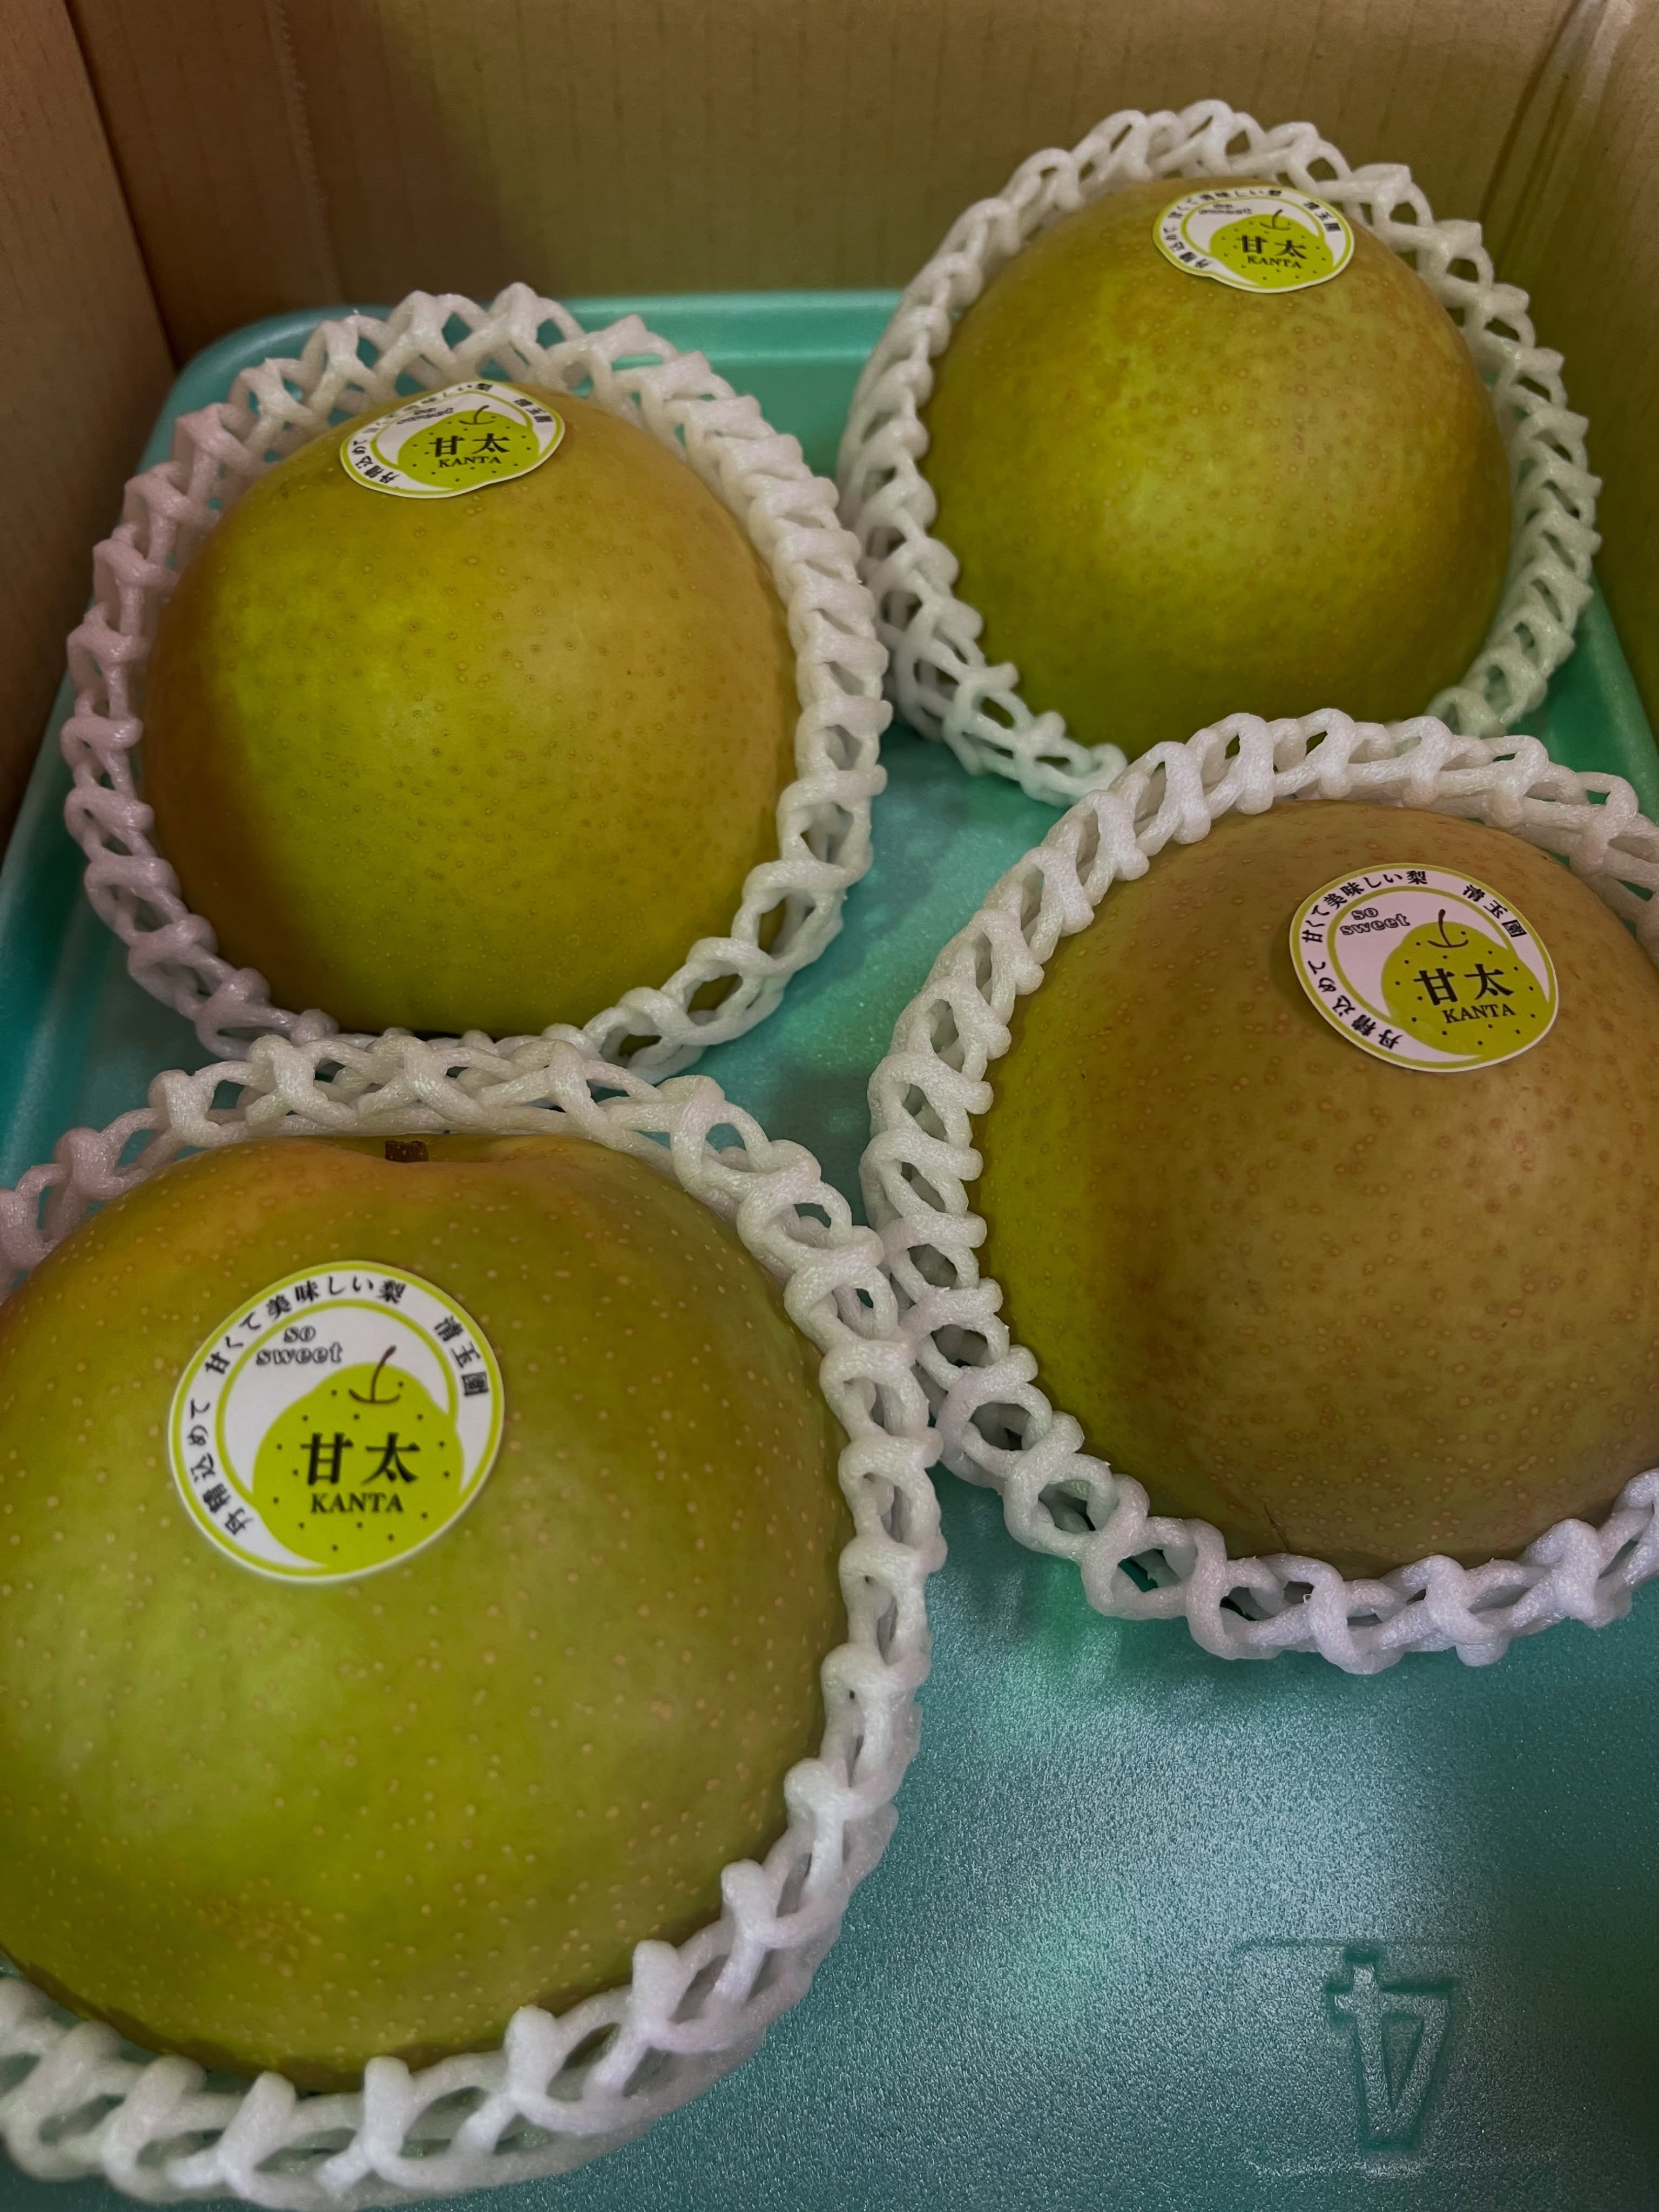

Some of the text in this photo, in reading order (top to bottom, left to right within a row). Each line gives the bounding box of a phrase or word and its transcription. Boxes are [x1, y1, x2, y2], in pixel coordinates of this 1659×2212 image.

[1236, 234, 1307, 260] 甘太
[1246, 255, 1302, 269] KANTA
[429, 433, 510, 457] 甘太
[438, 456, 502, 468] KANTA
[1301, 870, 1428, 943] 甘くて美味しい梨
[1339, 913, 1411, 936] sweet
[1413, 963, 1514, 1006] 甘太
[1441, 1003, 1516, 1024] KANTA
[205, 1275, 407, 1376] 甘くて美味しい梨
[256, 1342, 343, 1366] sweet
[300, 1432, 421, 1486] 甘太
[311, 1493, 404, 1514] KANTA
[1324, 1947, 1455, 2152] 4
